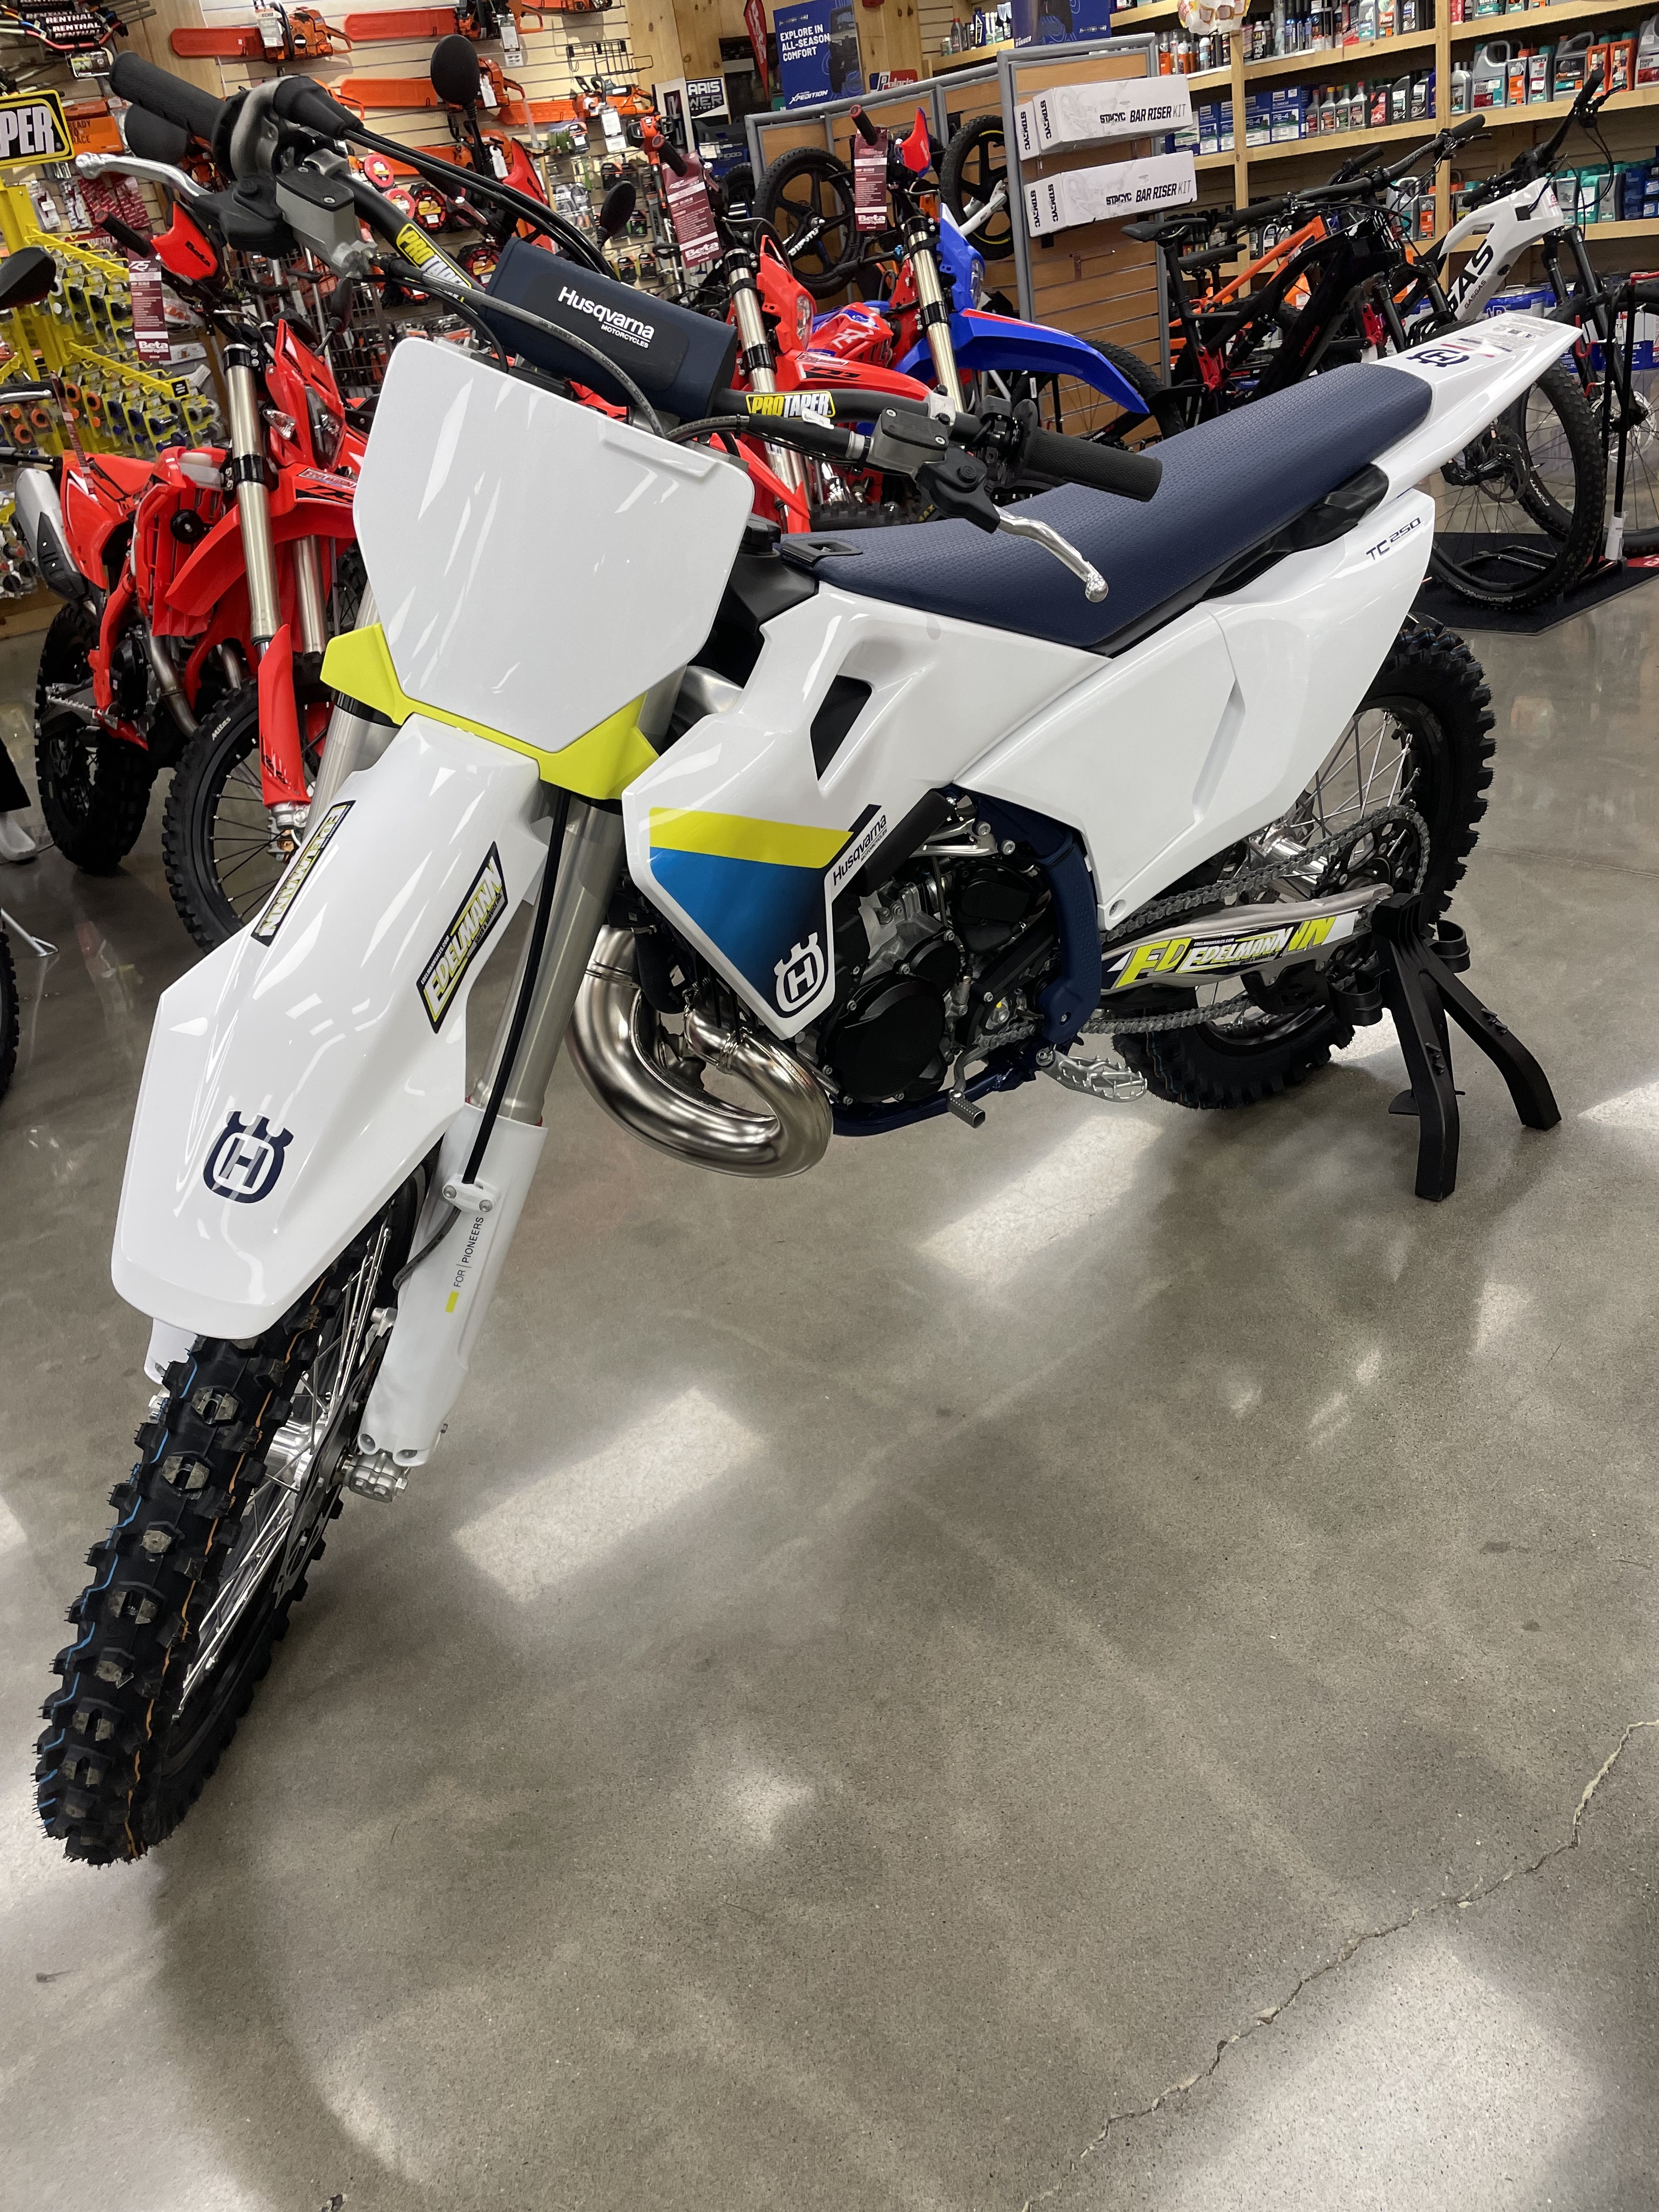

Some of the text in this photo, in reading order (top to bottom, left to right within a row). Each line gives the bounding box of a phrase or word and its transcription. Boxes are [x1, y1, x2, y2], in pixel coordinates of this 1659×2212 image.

[46, 13, 94, 24] RENTHAL
[52, 22, 101, 32] RENTHAL
[780, 24, 824, 42] EXPLORE IN
[781, 33, 831, 52] ALL-SEASON
[783, 46, 817, 61] COMFORT
[789, 89, 828, 104] XPEDITION
[1099, 104, 1186, 124] STACYC BAR RISER KIT
[1106, 180, 1192, 206] STACYC BAR RISER KIT
[685, 241, 719, 258] Beta
[1464, 279, 1486, 309] GASGAS
[557, 286, 654, 340] Husqvarna
[138, 340, 169, 349] Beta
[601, 324, 649, 349] MOTORCYCLES
[752, 393, 830, 418] PROTAPER
[1365, 517, 1421, 560] TC 250
[833, 815, 887, 887] Husqvarna
[423, 855, 503, 1020] EDELMANN
[1179, 926, 1294, 972] EDELMANN
[420, 935, 450, 985] EDELMANNSALES.COM
[453, 1217, 484, 1288] FOR PIONEERS
